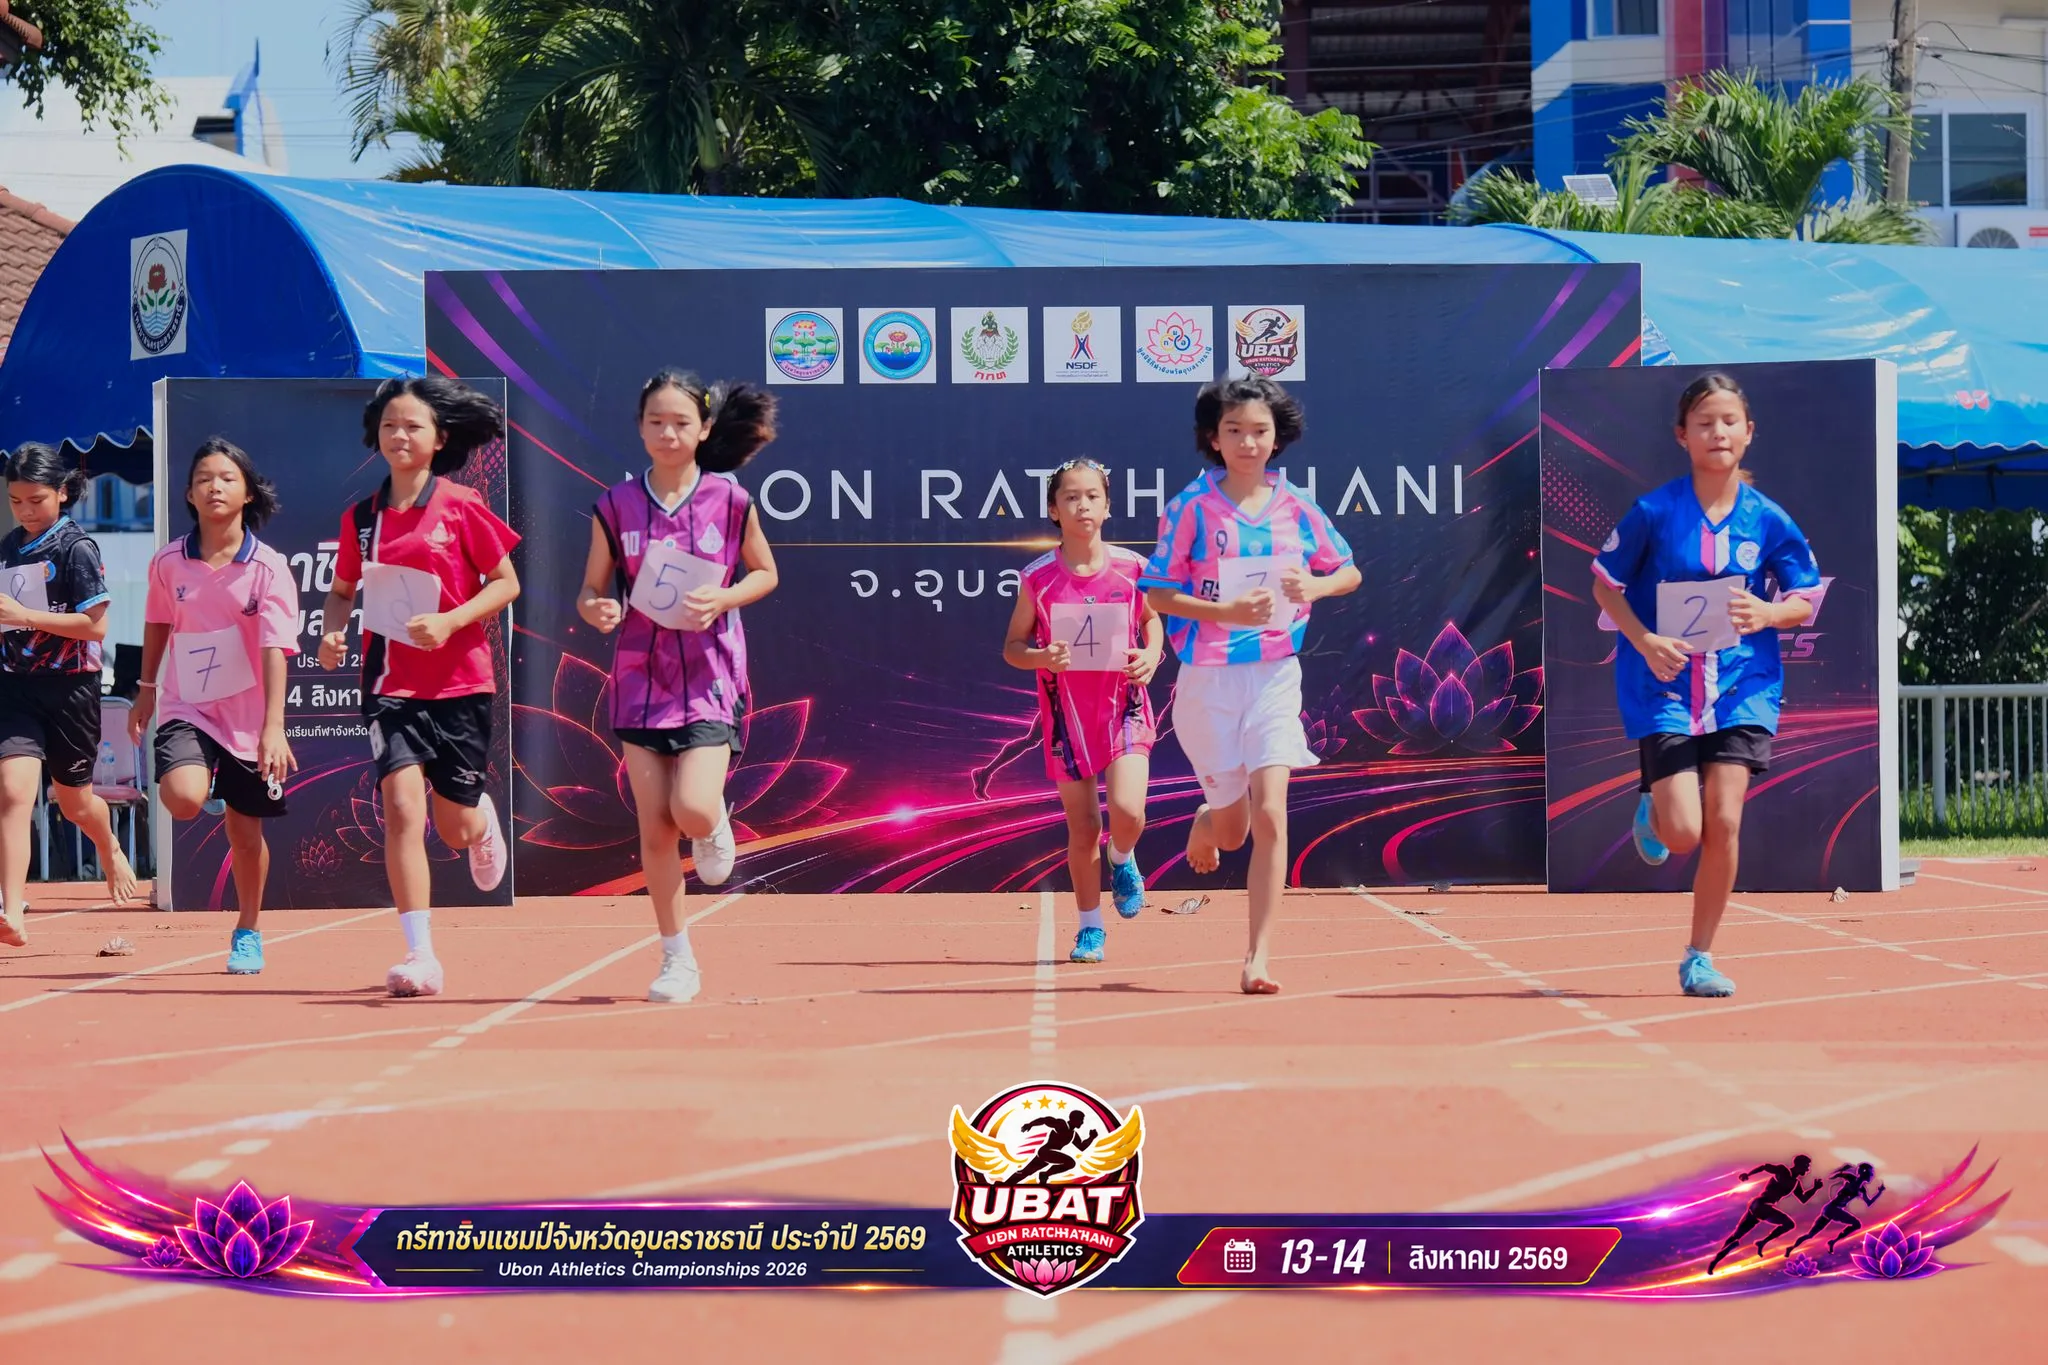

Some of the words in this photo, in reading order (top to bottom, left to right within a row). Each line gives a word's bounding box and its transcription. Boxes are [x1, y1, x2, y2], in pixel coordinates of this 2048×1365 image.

[1066, 362, 1097, 370] NSDF
[1241, 344, 1293, 358] UBAT
[620, 531, 640, 557] 10
[1216, 530, 1228, 556] 9
[650, 563, 688, 611] 5
[1682, 595, 1709, 637] 2
[1073, 614, 1101, 658] 4
[189, 646, 222, 692] 7
